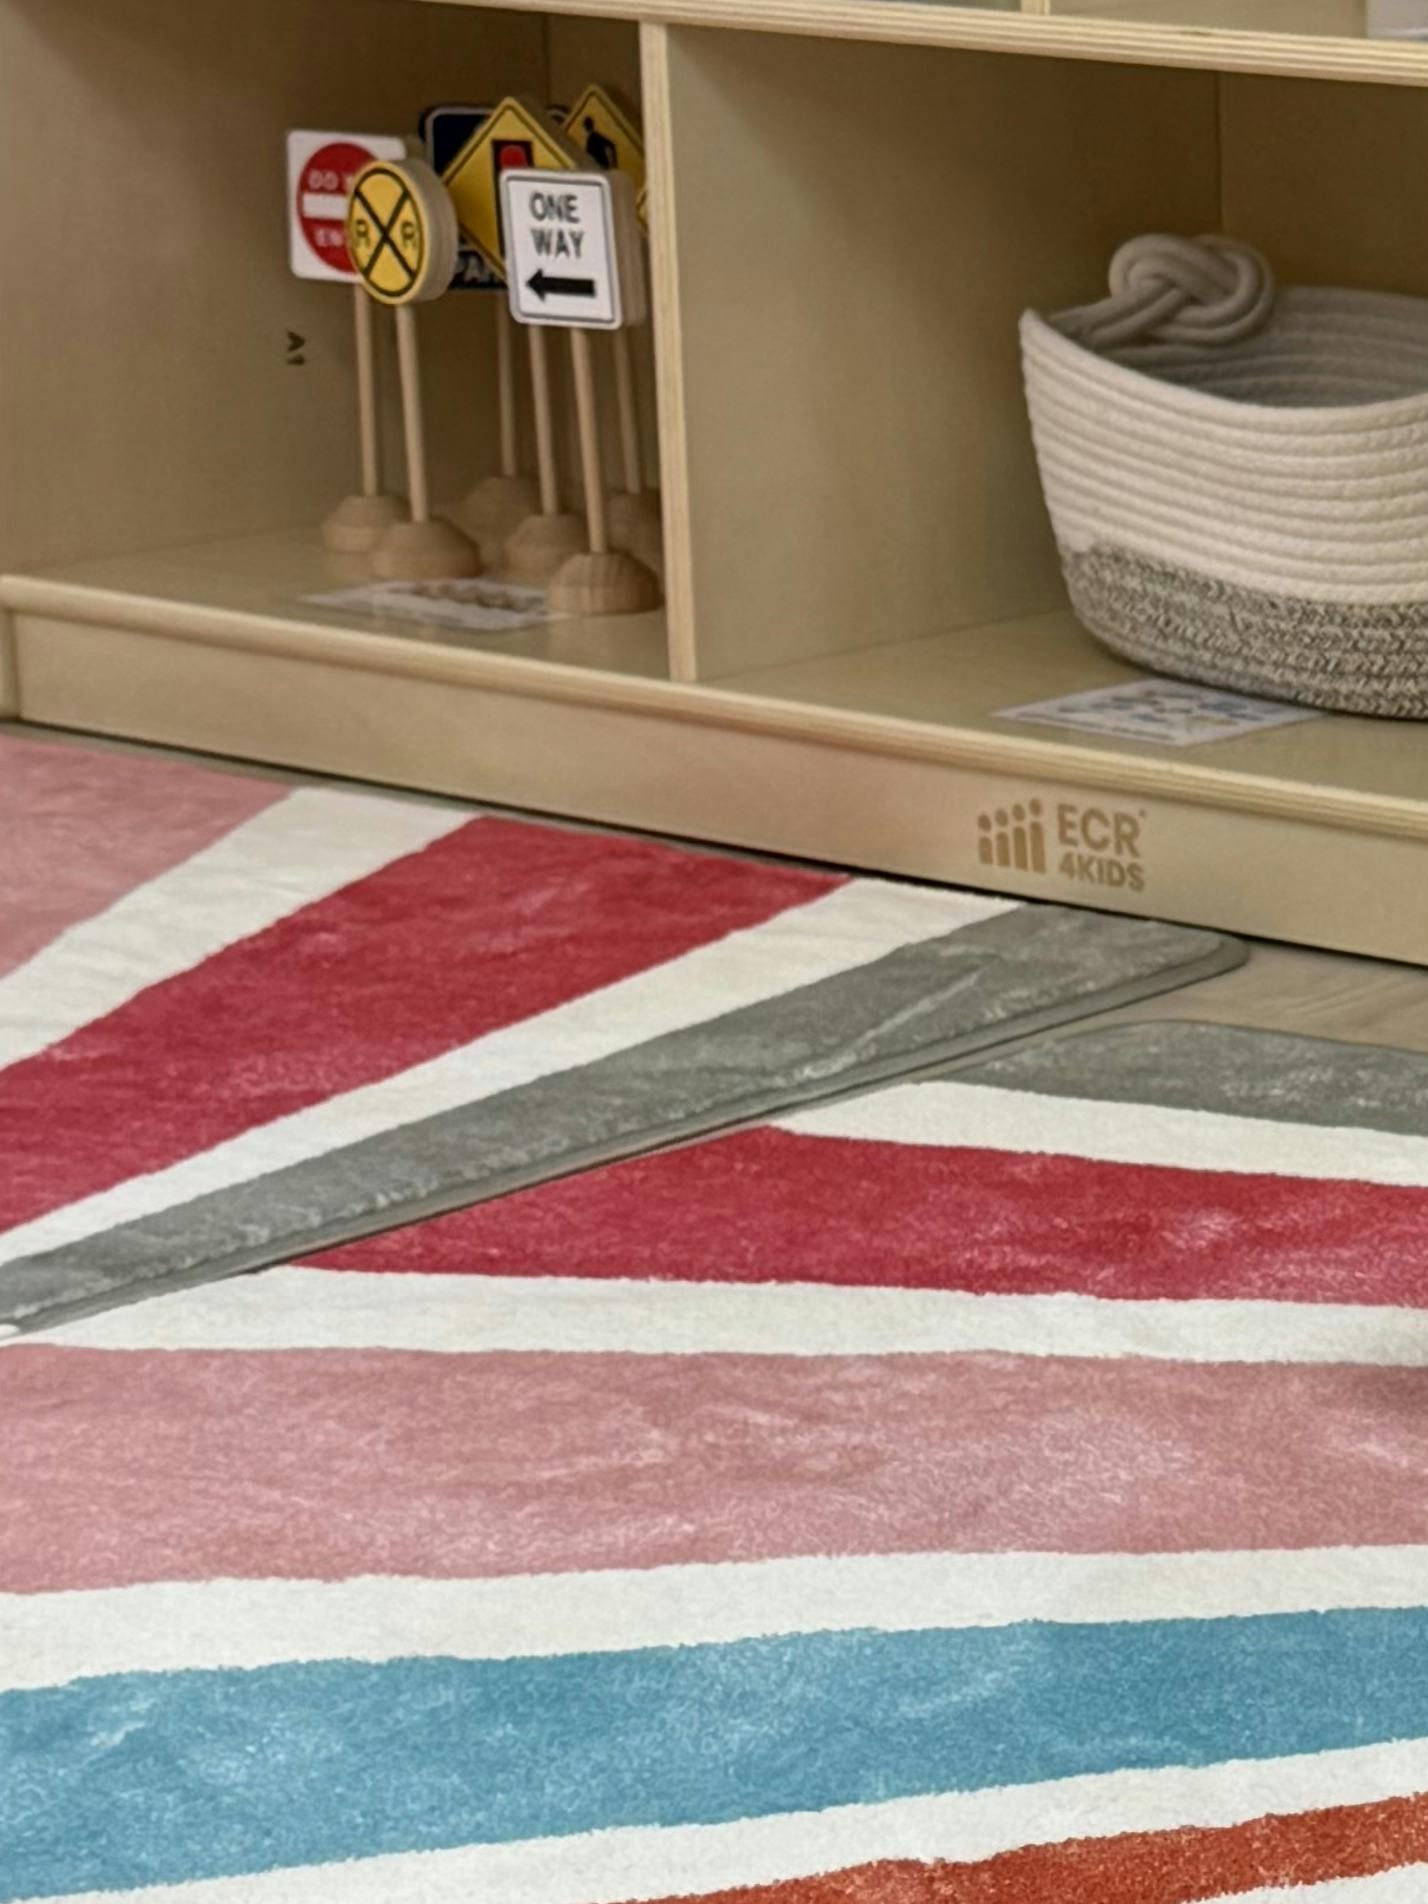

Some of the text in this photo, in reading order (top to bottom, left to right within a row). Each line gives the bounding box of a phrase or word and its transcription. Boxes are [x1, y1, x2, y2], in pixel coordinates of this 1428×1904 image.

[529, 192, 581, 223] ONE
[531, 228, 584, 259] WAY
[1057, 803, 1140, 858] ECR
[1059, 851, 1145, 892] 4KIDS
